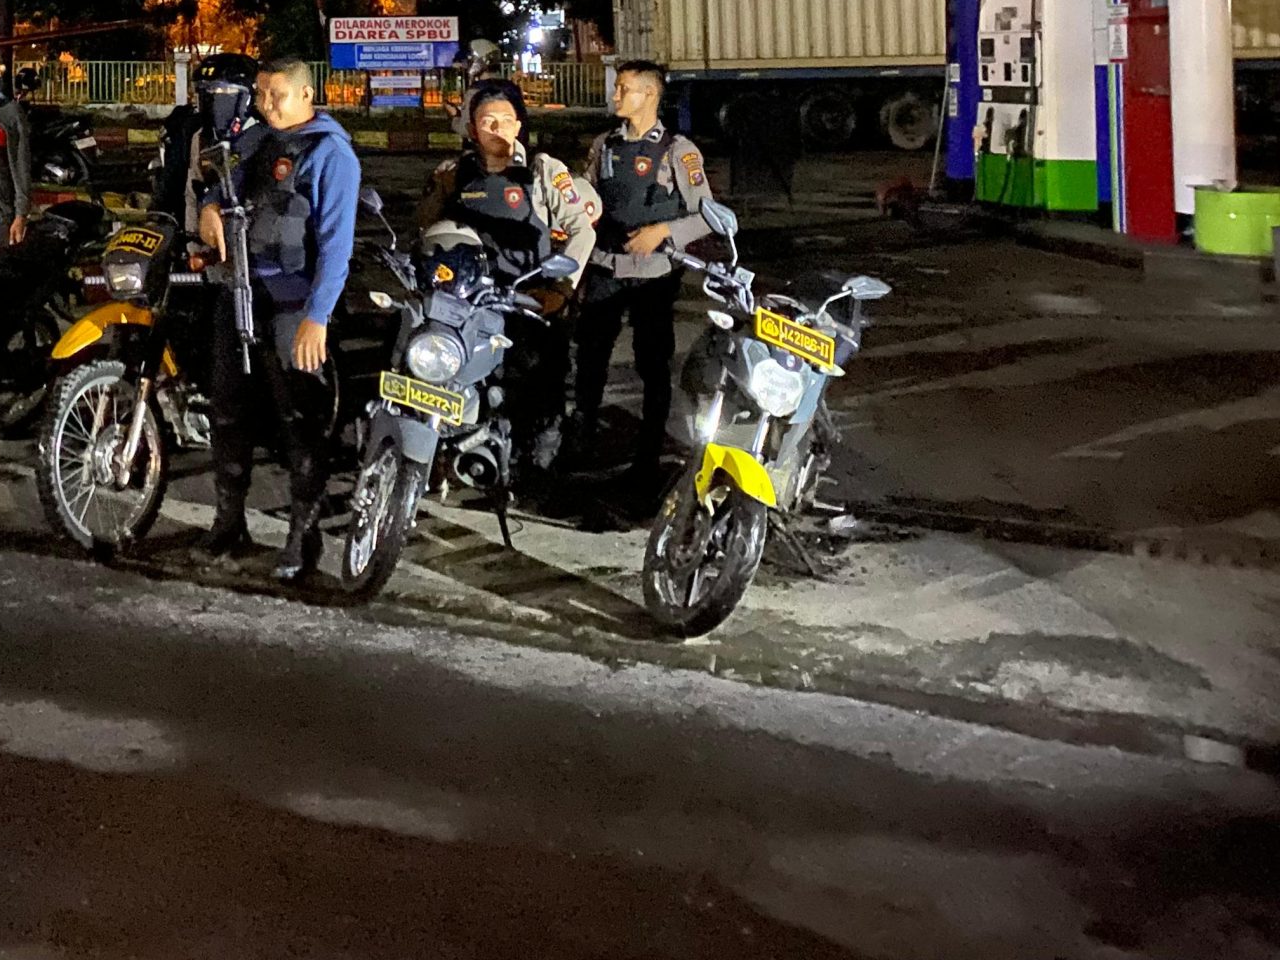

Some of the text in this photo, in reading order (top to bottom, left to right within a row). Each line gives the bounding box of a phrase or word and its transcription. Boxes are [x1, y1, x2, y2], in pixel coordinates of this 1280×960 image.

[334, 19, 451, 30] DILARANG MEROKOK
[335, 30, 452, 40] DIAREA SPBU
